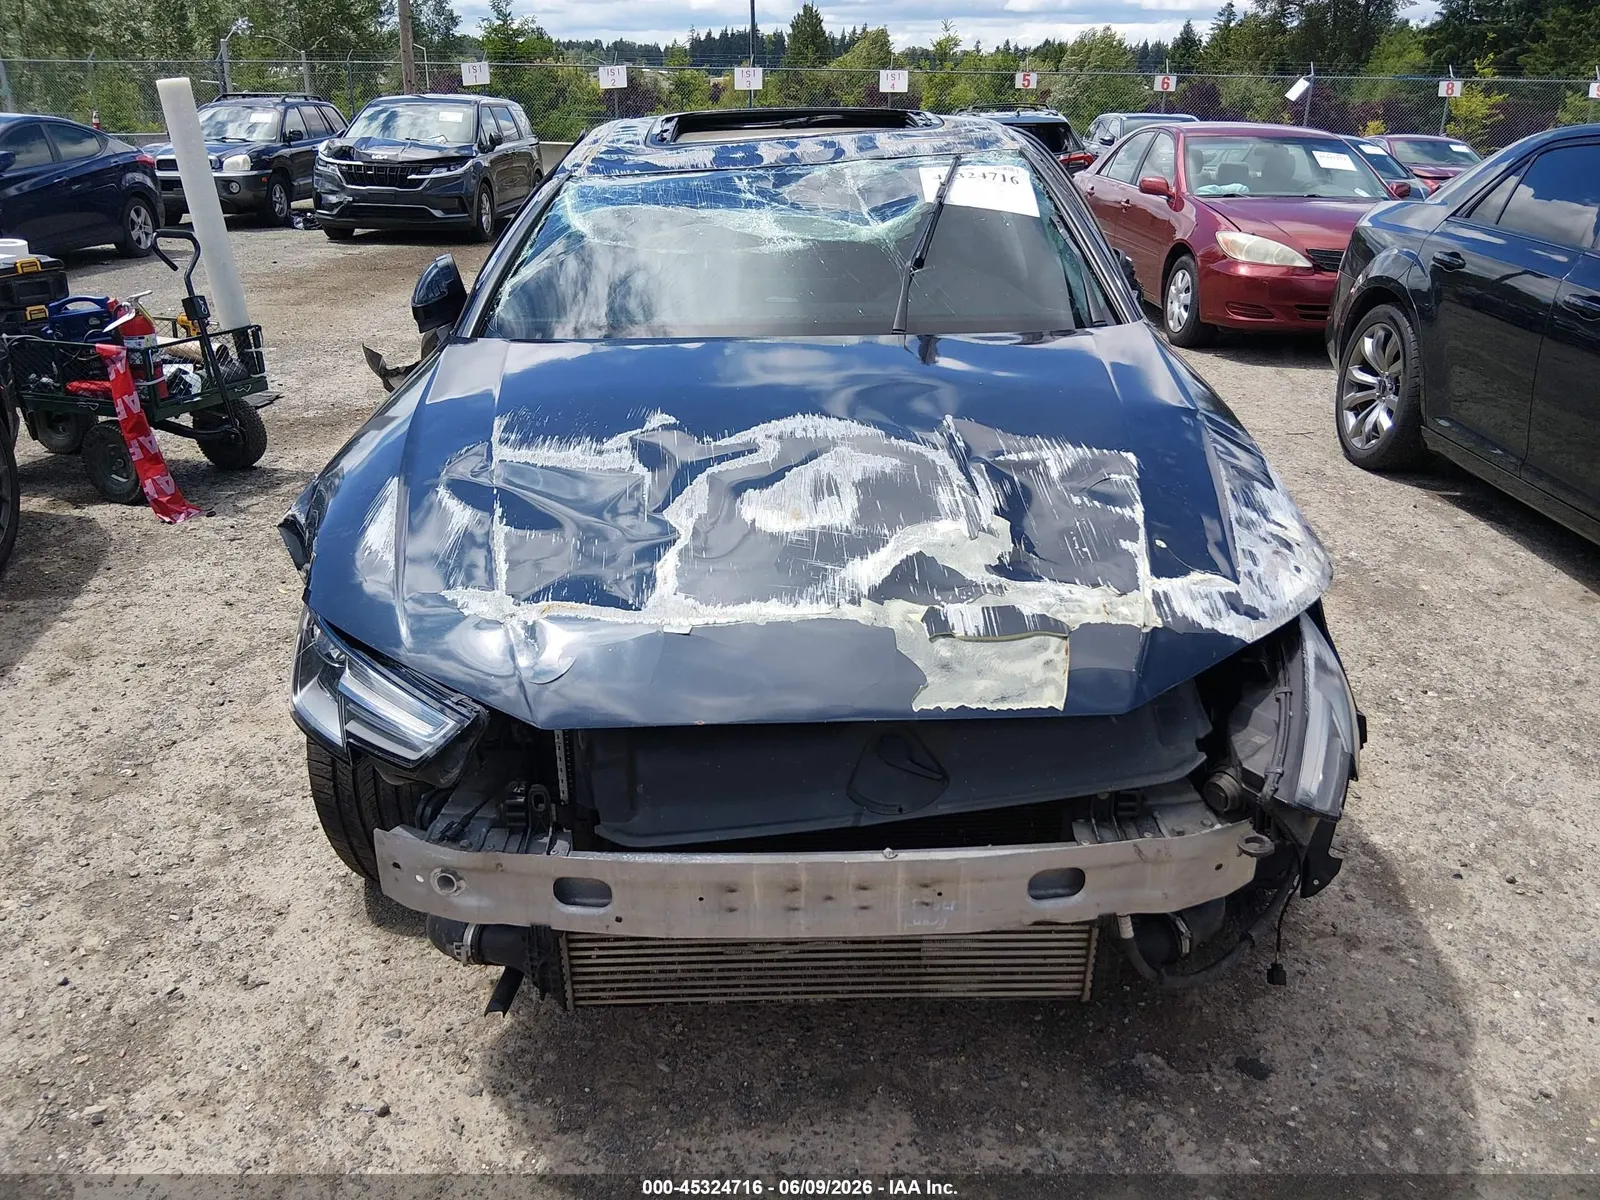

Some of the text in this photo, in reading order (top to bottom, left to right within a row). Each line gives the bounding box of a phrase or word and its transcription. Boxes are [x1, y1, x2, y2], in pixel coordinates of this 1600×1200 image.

[1022, 73, 1031, 88] 5
[1161, 76, 1170, 91] 6
[1445, 81, 1455, 96] 8
[933, 171, 1019, 185] 4324716
